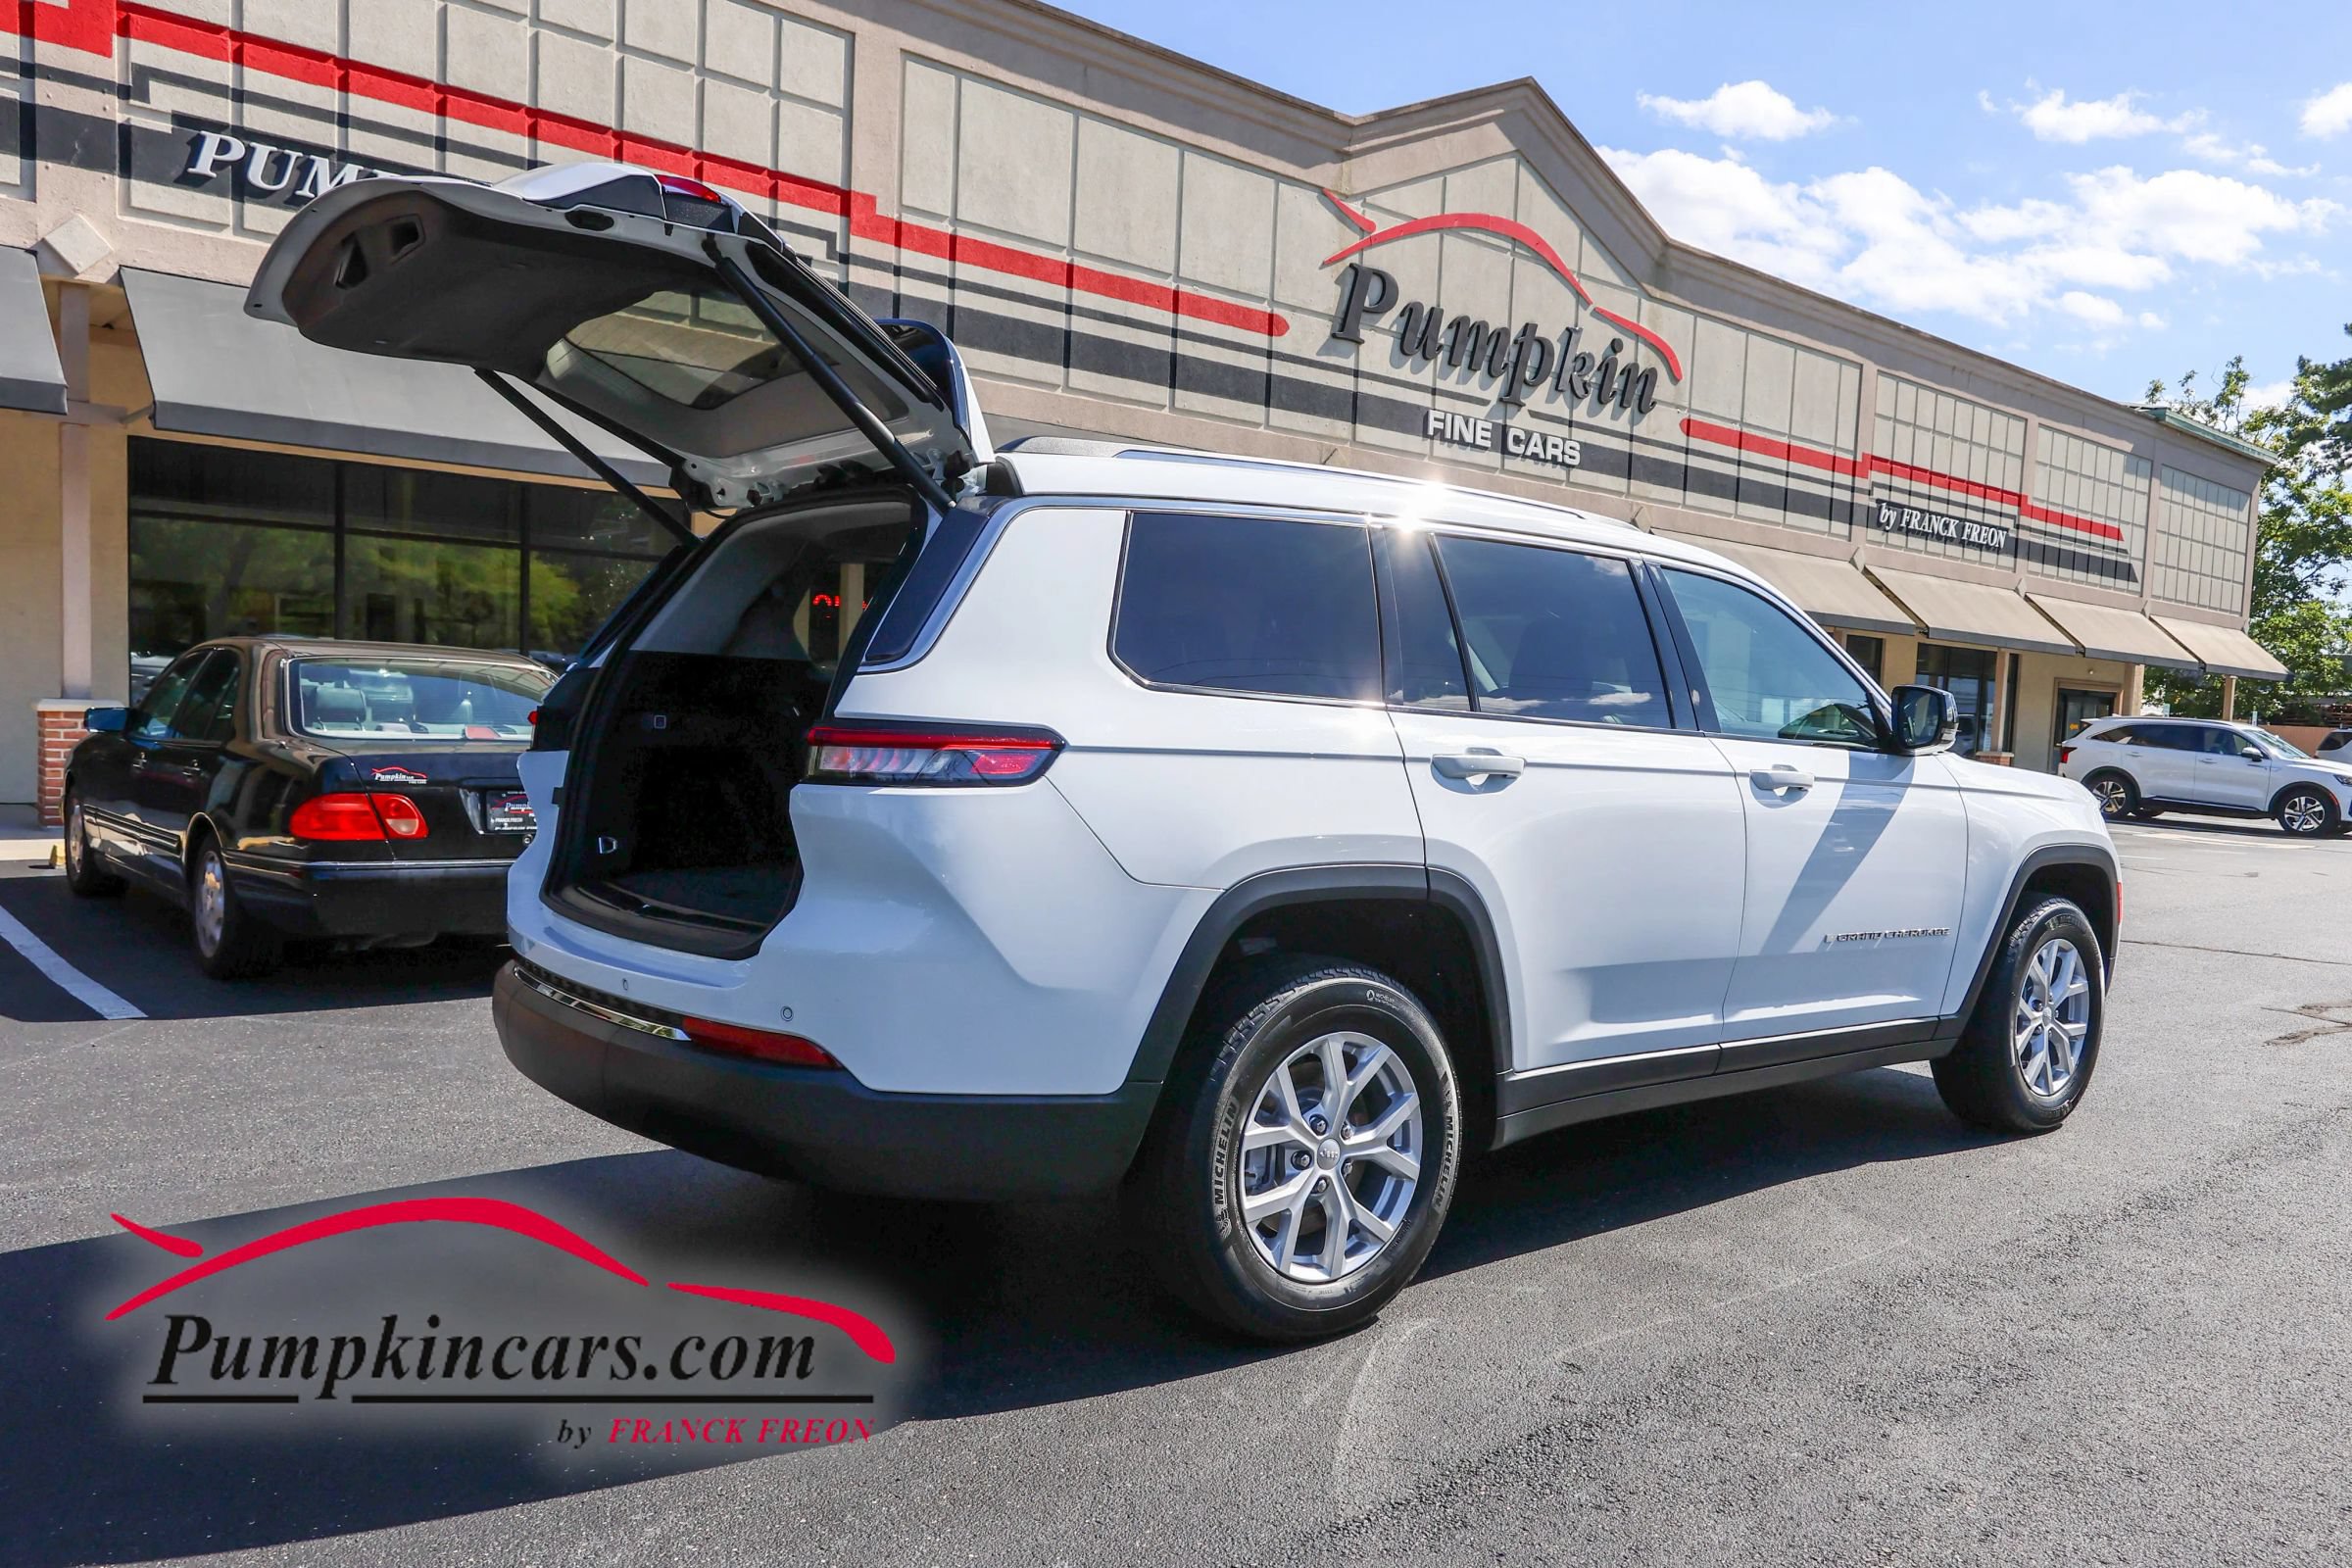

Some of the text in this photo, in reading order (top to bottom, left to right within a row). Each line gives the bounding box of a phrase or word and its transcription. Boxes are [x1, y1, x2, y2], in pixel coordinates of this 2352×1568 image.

[187, 129, 402, 198] PUM
[1332, 263, 1658, 415] Pumpkin
[1427, 409, 1581, 466] FINE CARS
[1879, 503, 2007, 549] by FRANCK FREON
[1214, 1101, 1238, 1206] MICHELIN
[1435, 1115, 1453, 1207] MICHELIN
